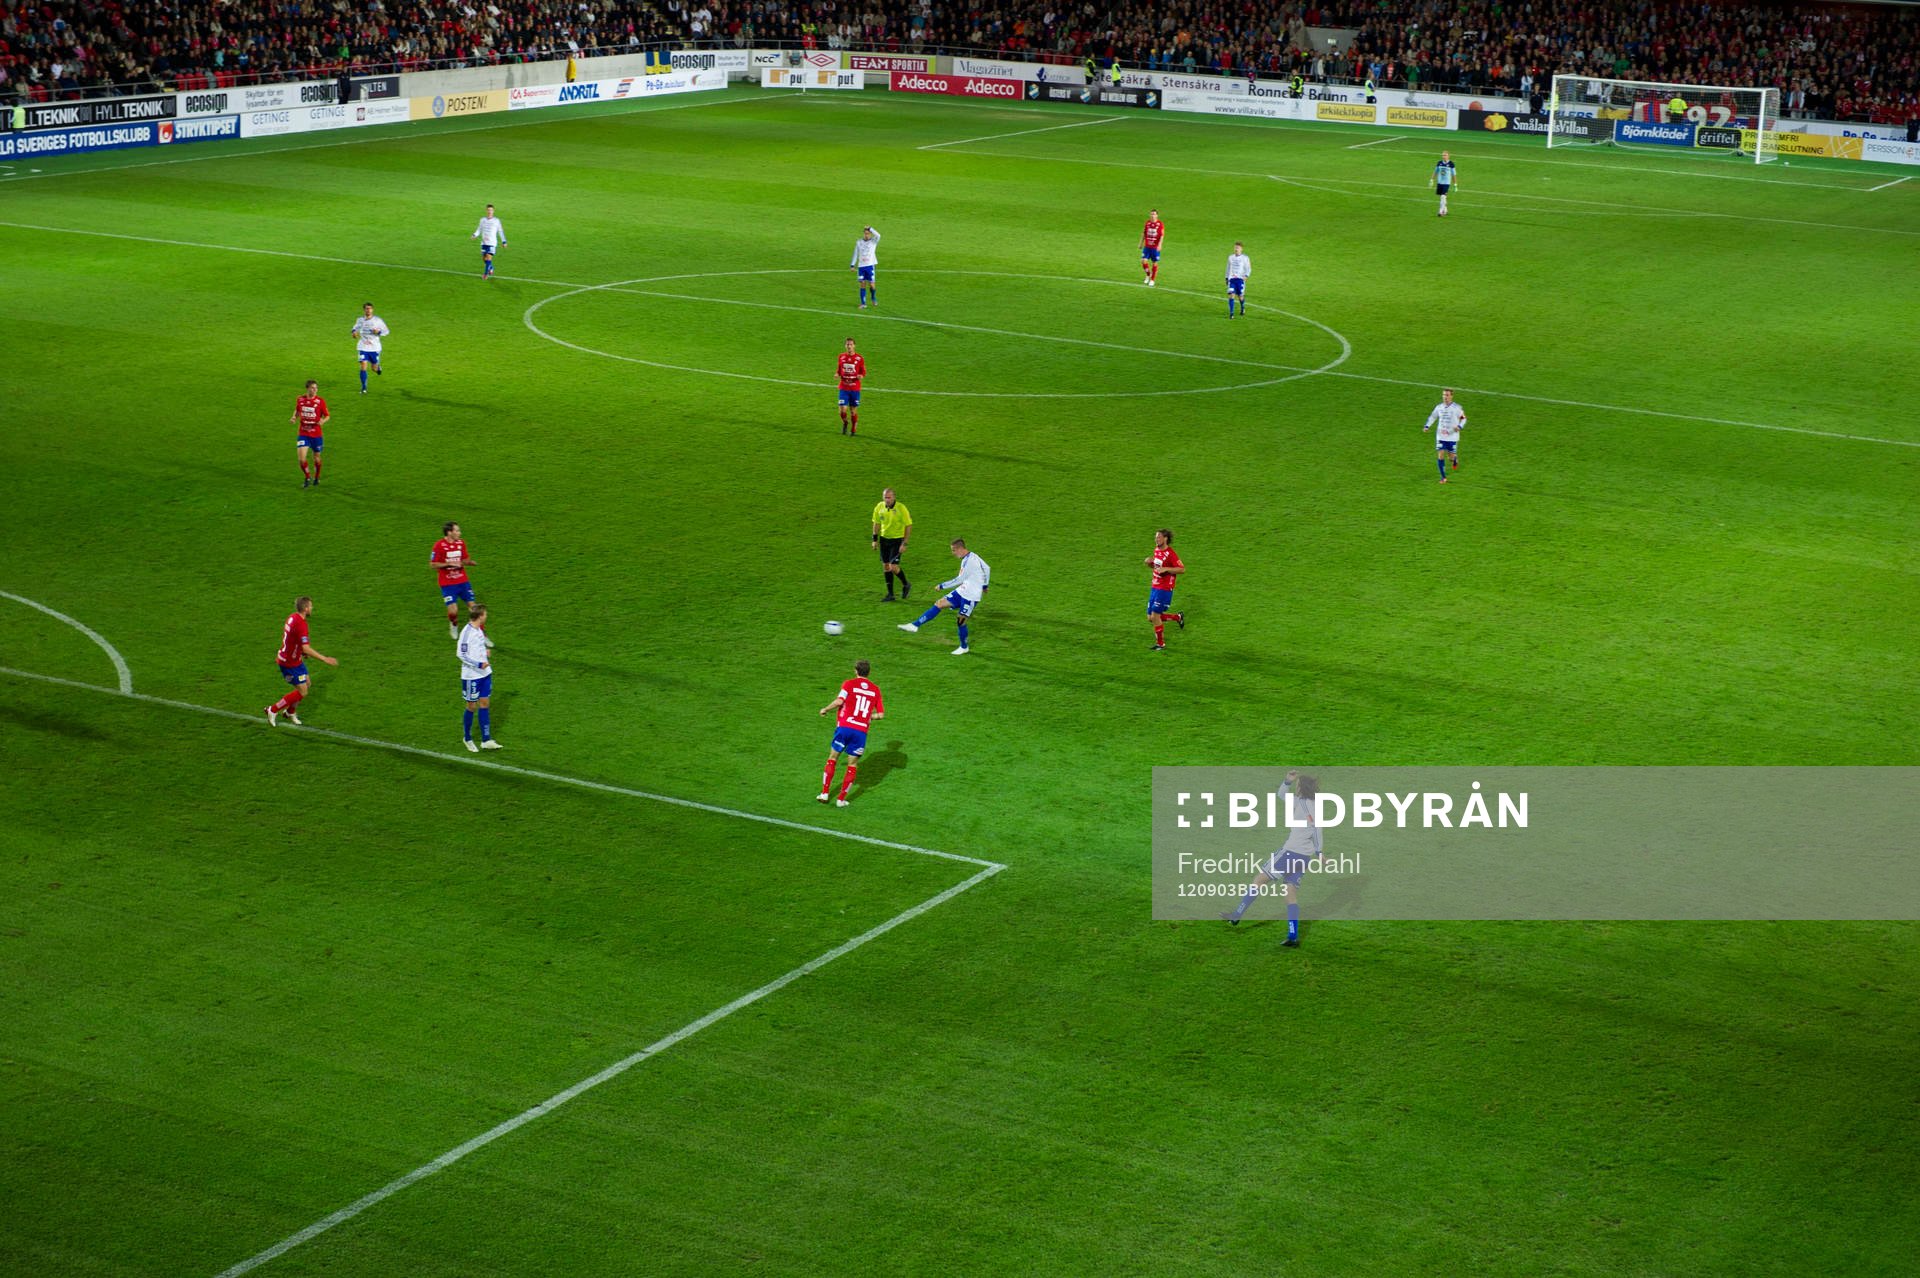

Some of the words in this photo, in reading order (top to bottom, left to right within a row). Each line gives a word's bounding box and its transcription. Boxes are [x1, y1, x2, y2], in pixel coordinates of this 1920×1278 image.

[672, 54, 715, 71] ecosign
[852, 57, 888, 70] TEAM
[891, 60, 926, 72] SPORTIA
[959, 60, 1014, 77] Magazinet
[898, 75, 948, 91] Adecco
[965, 79, 1015, 97] Adecco
[511, 88, 522, 99] ICA
[558, 83, 600, 102] ANDRITZ
[1308, 88, 1348, 103] Brunn
[186, 93, 228, 114] ecosign
[447, 96, 488, 112] POSTEN!
[1215, 105, 1276, 117] www.villavik.se
[252, 111, 290, 125] GETINGE
[310, 106, 345, 120] GETINGE
[1319, 106, 1374, 119] arkitektkopia
[1390, 111, 1445, 124] arkitektkopia
[175, 116, 237, 139] STRYKTIPSET
[1622, 125, 1688, 142] Björnkläder
[17, 134, 67, 154] SVERIGES
[69, 126, 151, 148] FOTBOLLSKLUBB
[1867, 144, 1905, 154] PERSSON
[853, 694, 871, 718] 14
